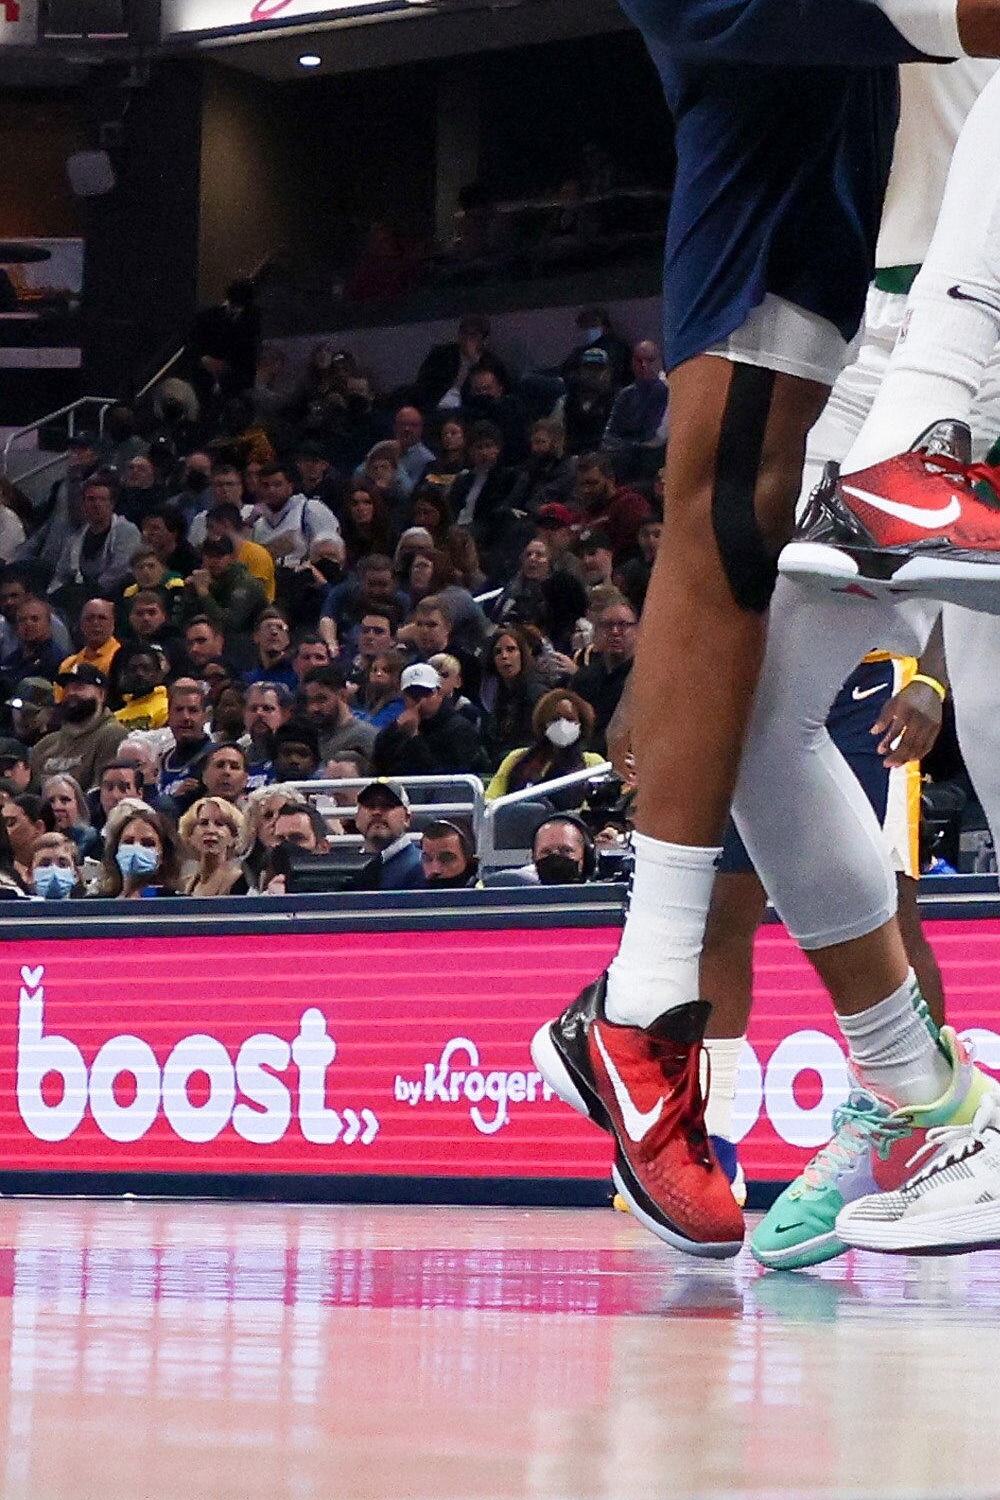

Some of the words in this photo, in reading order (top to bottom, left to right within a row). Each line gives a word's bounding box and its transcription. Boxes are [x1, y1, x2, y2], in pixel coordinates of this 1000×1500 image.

[16, 980, 343, 1143] boost
[394, 1075, 422, 1106] by
[424, 1037, 542, 1135] Kroger
